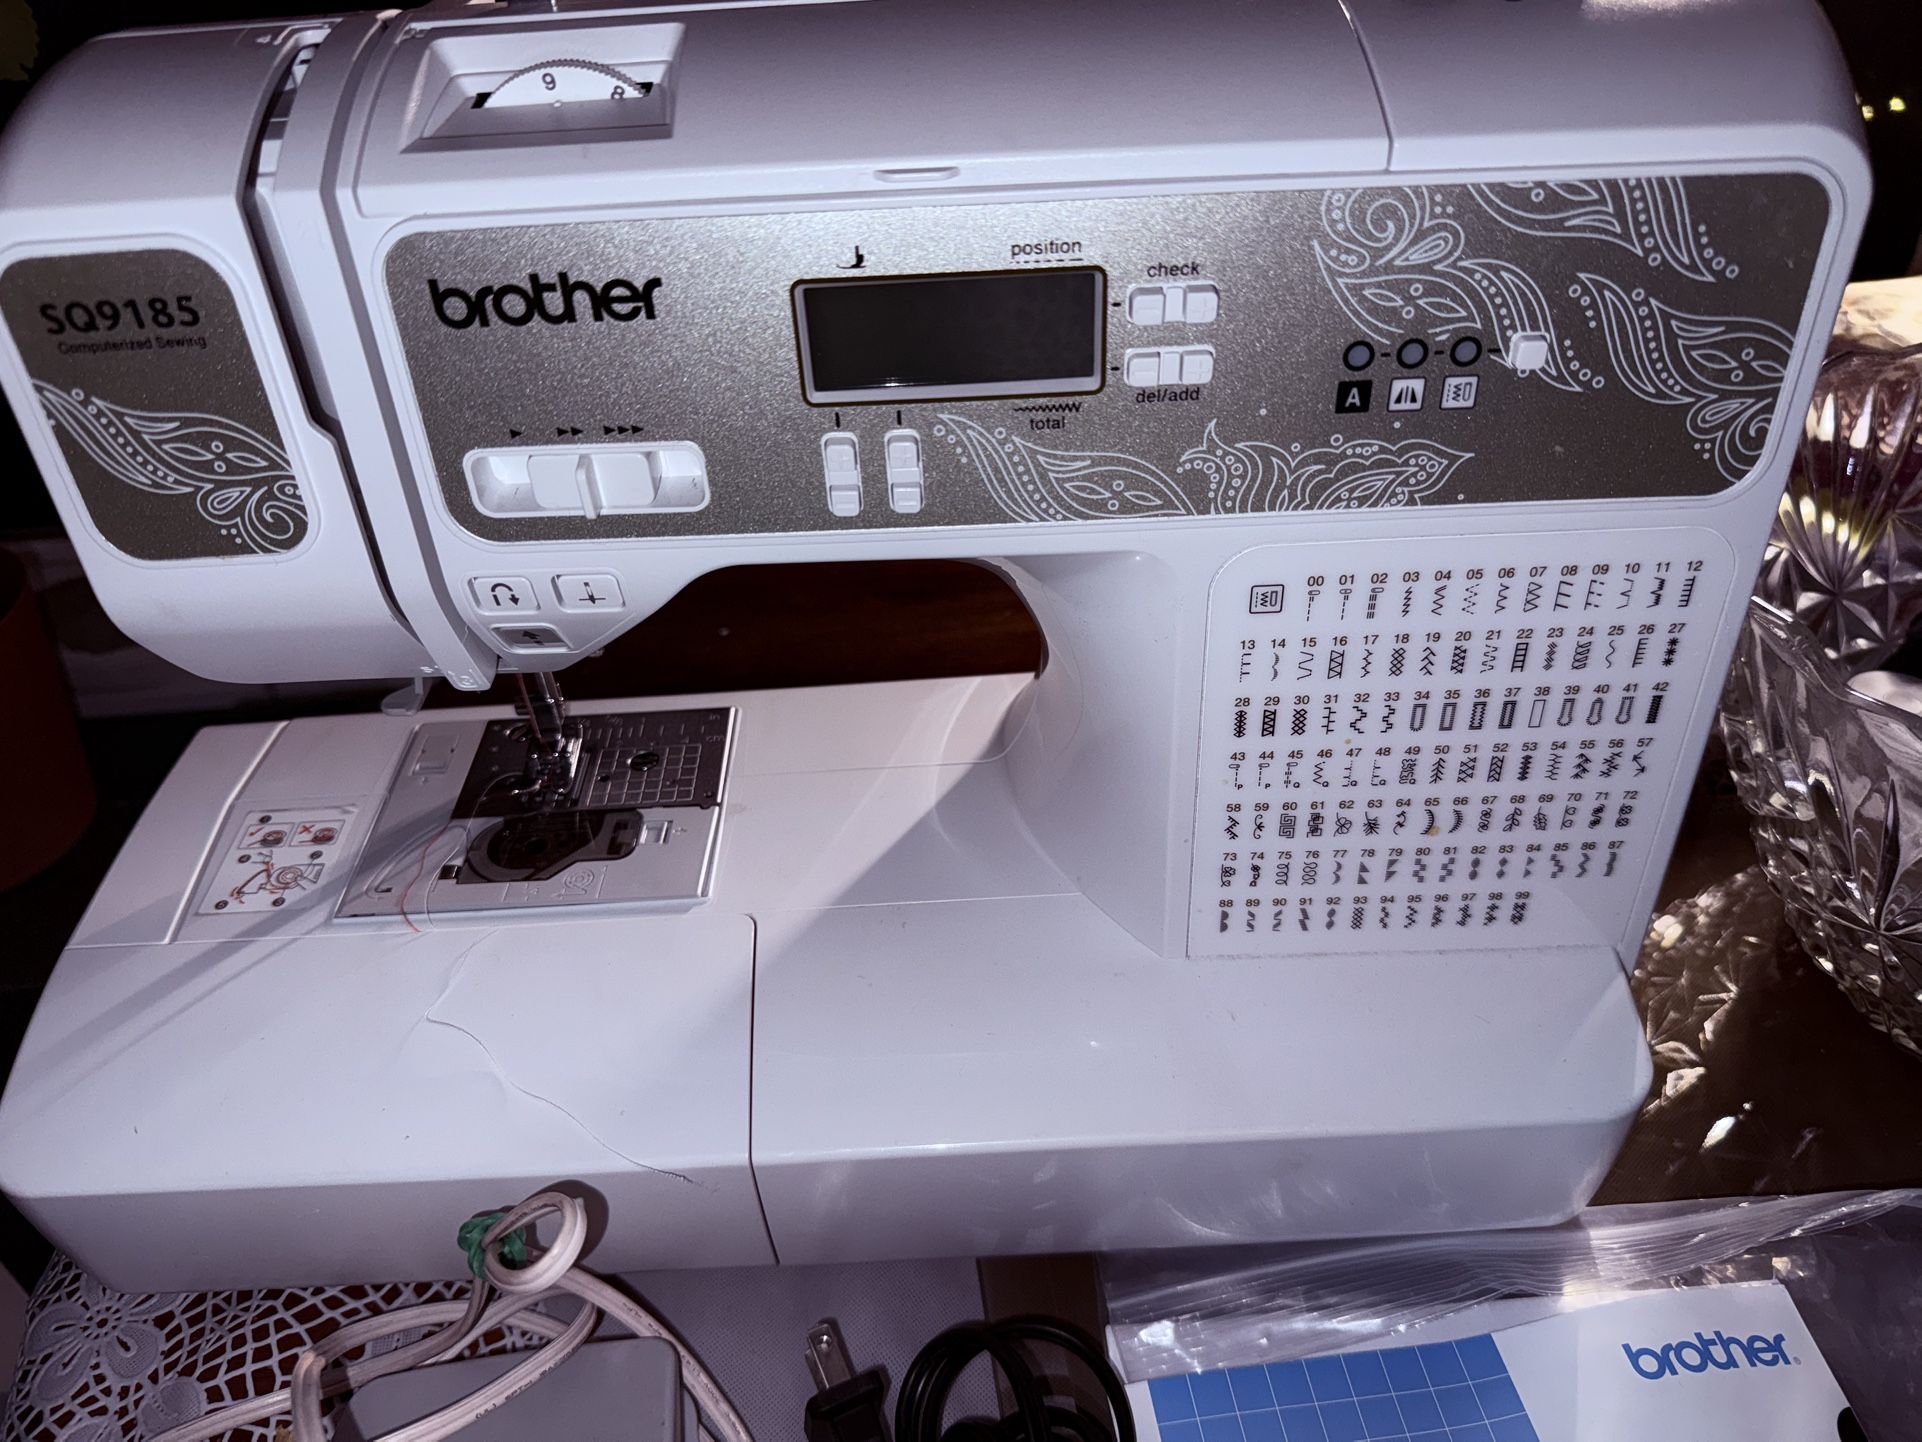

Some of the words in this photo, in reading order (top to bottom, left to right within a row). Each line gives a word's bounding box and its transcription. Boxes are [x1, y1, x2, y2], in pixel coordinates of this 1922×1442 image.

[542, 73, 557, 91] 9
[1010, 239, 1083, 256] position
[1147, 261, 1200, 278] check
[427, 271, 663, 330] brother
[39, 295, 200, 335] SQ9185
[57, 337, 153, 355] Computerized
[155, 335, 208, 350] Sewing
[1135, 387, 1200, 403] del/add
[1344, 386, 1361, 407] A
[1030, 415, 1066, 431] total
[1307, 576, 1324, 587] 00
[1339, 574, 1354, 585] 01
[1371, 573, 1388, 584] 02
[1403, 571, 1420, 582] 03
[1435, 570, 1451, 581] 04
[1466, 569, 1483, 580] 05
[1498, 568, 1515, 579] 06
[1530, 566, 1547, 577] 07
[1561, 565, 1578, 576] 08
[1592, 564, 1609, 575] 09
[1625, 563, 1640, 574] 10
[1656, 562, 1670, 572] 11
[1688, 560, 1703, 571] 12
[1241, 640, 1255, 650] 13
[1271, 639, 1286, 649] 14
[1302, 637, 1317, 647] 15
[1333, 636, 1347, 646] 16
[1363, 635, 1379, 645] 17
[1394, 633, 1410, 644] 18
[1426, 632, 1441, 642] 19
[1454, 631, 1472, 641] 20
[1485, 630, 1501, 640] 21
[1516, 629, 1533, 639] 22
[1547, 627, 1564, 638] 23
[1577, 626, 1594, 637] 24
[1608, 625, 1624, 636] 25
[1638, 624, 1655, 634] 26
[1668, 623, 1686, 633] 27
[1234, 697, 1250, 707] 28
[1264, 696, 1280, 706] 29
[1294, 695, 1310, 705] 30
[1324, 694, 1338, 704] 31
[1354, 693, 1370, 703] 32
[1384, 692, 1400, 702] 33
[1414, 691, 1430, 701] 34
[1444, 690, 1460, 699] 35
[1474, 689, 1491, 698] 36
[1504, 687, 1521, 697] 37
[1534, 686, 1551, 696] 38
[1564, 685, 1580, 695] 39
[1593, 684, 1610, 694] 40
[1623, 683, 1638, 693] 41
[1652, 682, 1669, 692] 42
[1230, 752, 1245, 761] 43
[1259, 751, 1274, 760] 44
[1288, 750, 1303, 759] 45
[1317, 749, 1332, 758] 46
[1346, 748, 1362, 757] 47
[1375, 747, 1391, 756] 48
[1404, 746, 1420, 755] 49
[1434, 745, 1450, 754] 50
[1463, 744, 1478, 753] 51
[1492, 743, 1509, 752] 52
[1522, 742, 1538, 751] 53
[1551, 741, 1567, 750] 54
[1579, 740, 1595, 749] 55
[1608, 739, 1624, 748] 56
[1637, 738, 1653, 747] 57
[1226, 804, 1241, 812] 58
[1254, 803, 1269, 811] 59
[1282, 802, 1297, 811] 60
[1311, 801, 1324, 810] 61
[1339, 800, 1354, 809] 62
[1367, 799, 1382, 808] 63
[1396, 799, 1411, 807] 64
[1424, 798, 1440, 806] 65
[1453, 797, 1469, 806] 66
[1481, 796, 1498, 805] 67
[1510, 795, 1526, 804] 68
[1538, 794, 1554, 803] 69
[1567, 793, 1582, 801] 70
[1595, 792, 1609, 800] 71
[1623, 791, 1638, 799] 72
[1223, 853, 1237, 861] 73
[1251, 852, 1264, 860] 74
[1278, 851, 1292, 860] 75
[1305, 850, 1320, 859] 76
[1333, 850, 1347, 858] 77
[1361, 849, 1375, 857] 78
[1389, 848, 1403, 856] 79
[1415, 847, 1431, 856] 80
[1443, 847, 1457, 855] 81
[1471, 846, 1486, 854] 82
[1499, 845, 1514, 853] 83
[1526, 844, 1541, 852] 84
[1553, 843, 1569, 851] 85
[1581, 842, 1597, 850] 86
[1608, 841, 1624, 849] 87
[1219, 899, 1233, 907] 88
[1246, 899, 1260, 907] 89
[1273, 898, 1287, 906] 90
[1326, 897, 1341, 905] 92
[1353, 896, 1368, 904] 93
[1407, 895, 1422, 903] 95
[1434, 894, 1448, 902] 96
[1461, 893, 1476, 901] 97
[1488, 892, 1503, 900] 98
[1515, 891, 1530, 900] 99
[1621, 1330, 1792, 1380] brother
